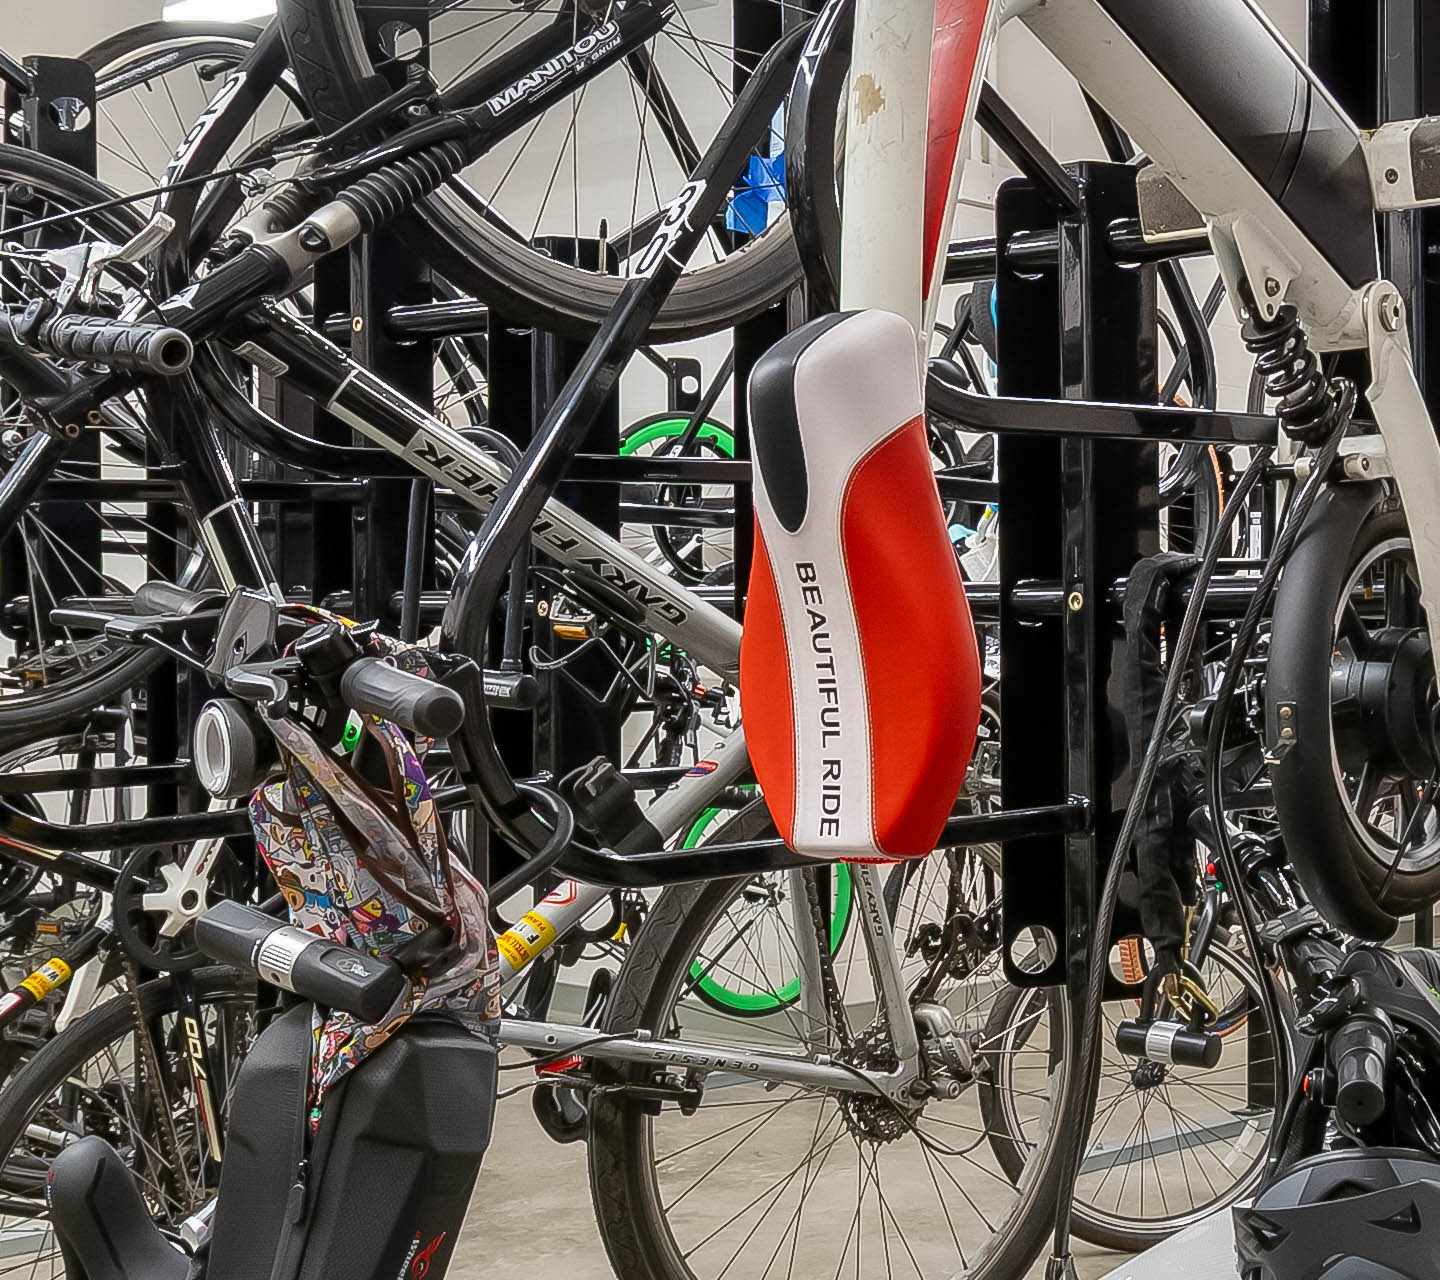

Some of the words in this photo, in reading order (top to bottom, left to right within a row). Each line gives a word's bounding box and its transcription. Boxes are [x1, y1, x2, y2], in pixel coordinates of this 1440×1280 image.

[487, 19, 620, 116] MANITOU
[574, 32, 623, 75] MGNUM
[796, 562, 841, 749] BEAUTIFUL
[819, 759, 841, 838] RIDE
[652, 1050, 761, 1072] GENESIS
